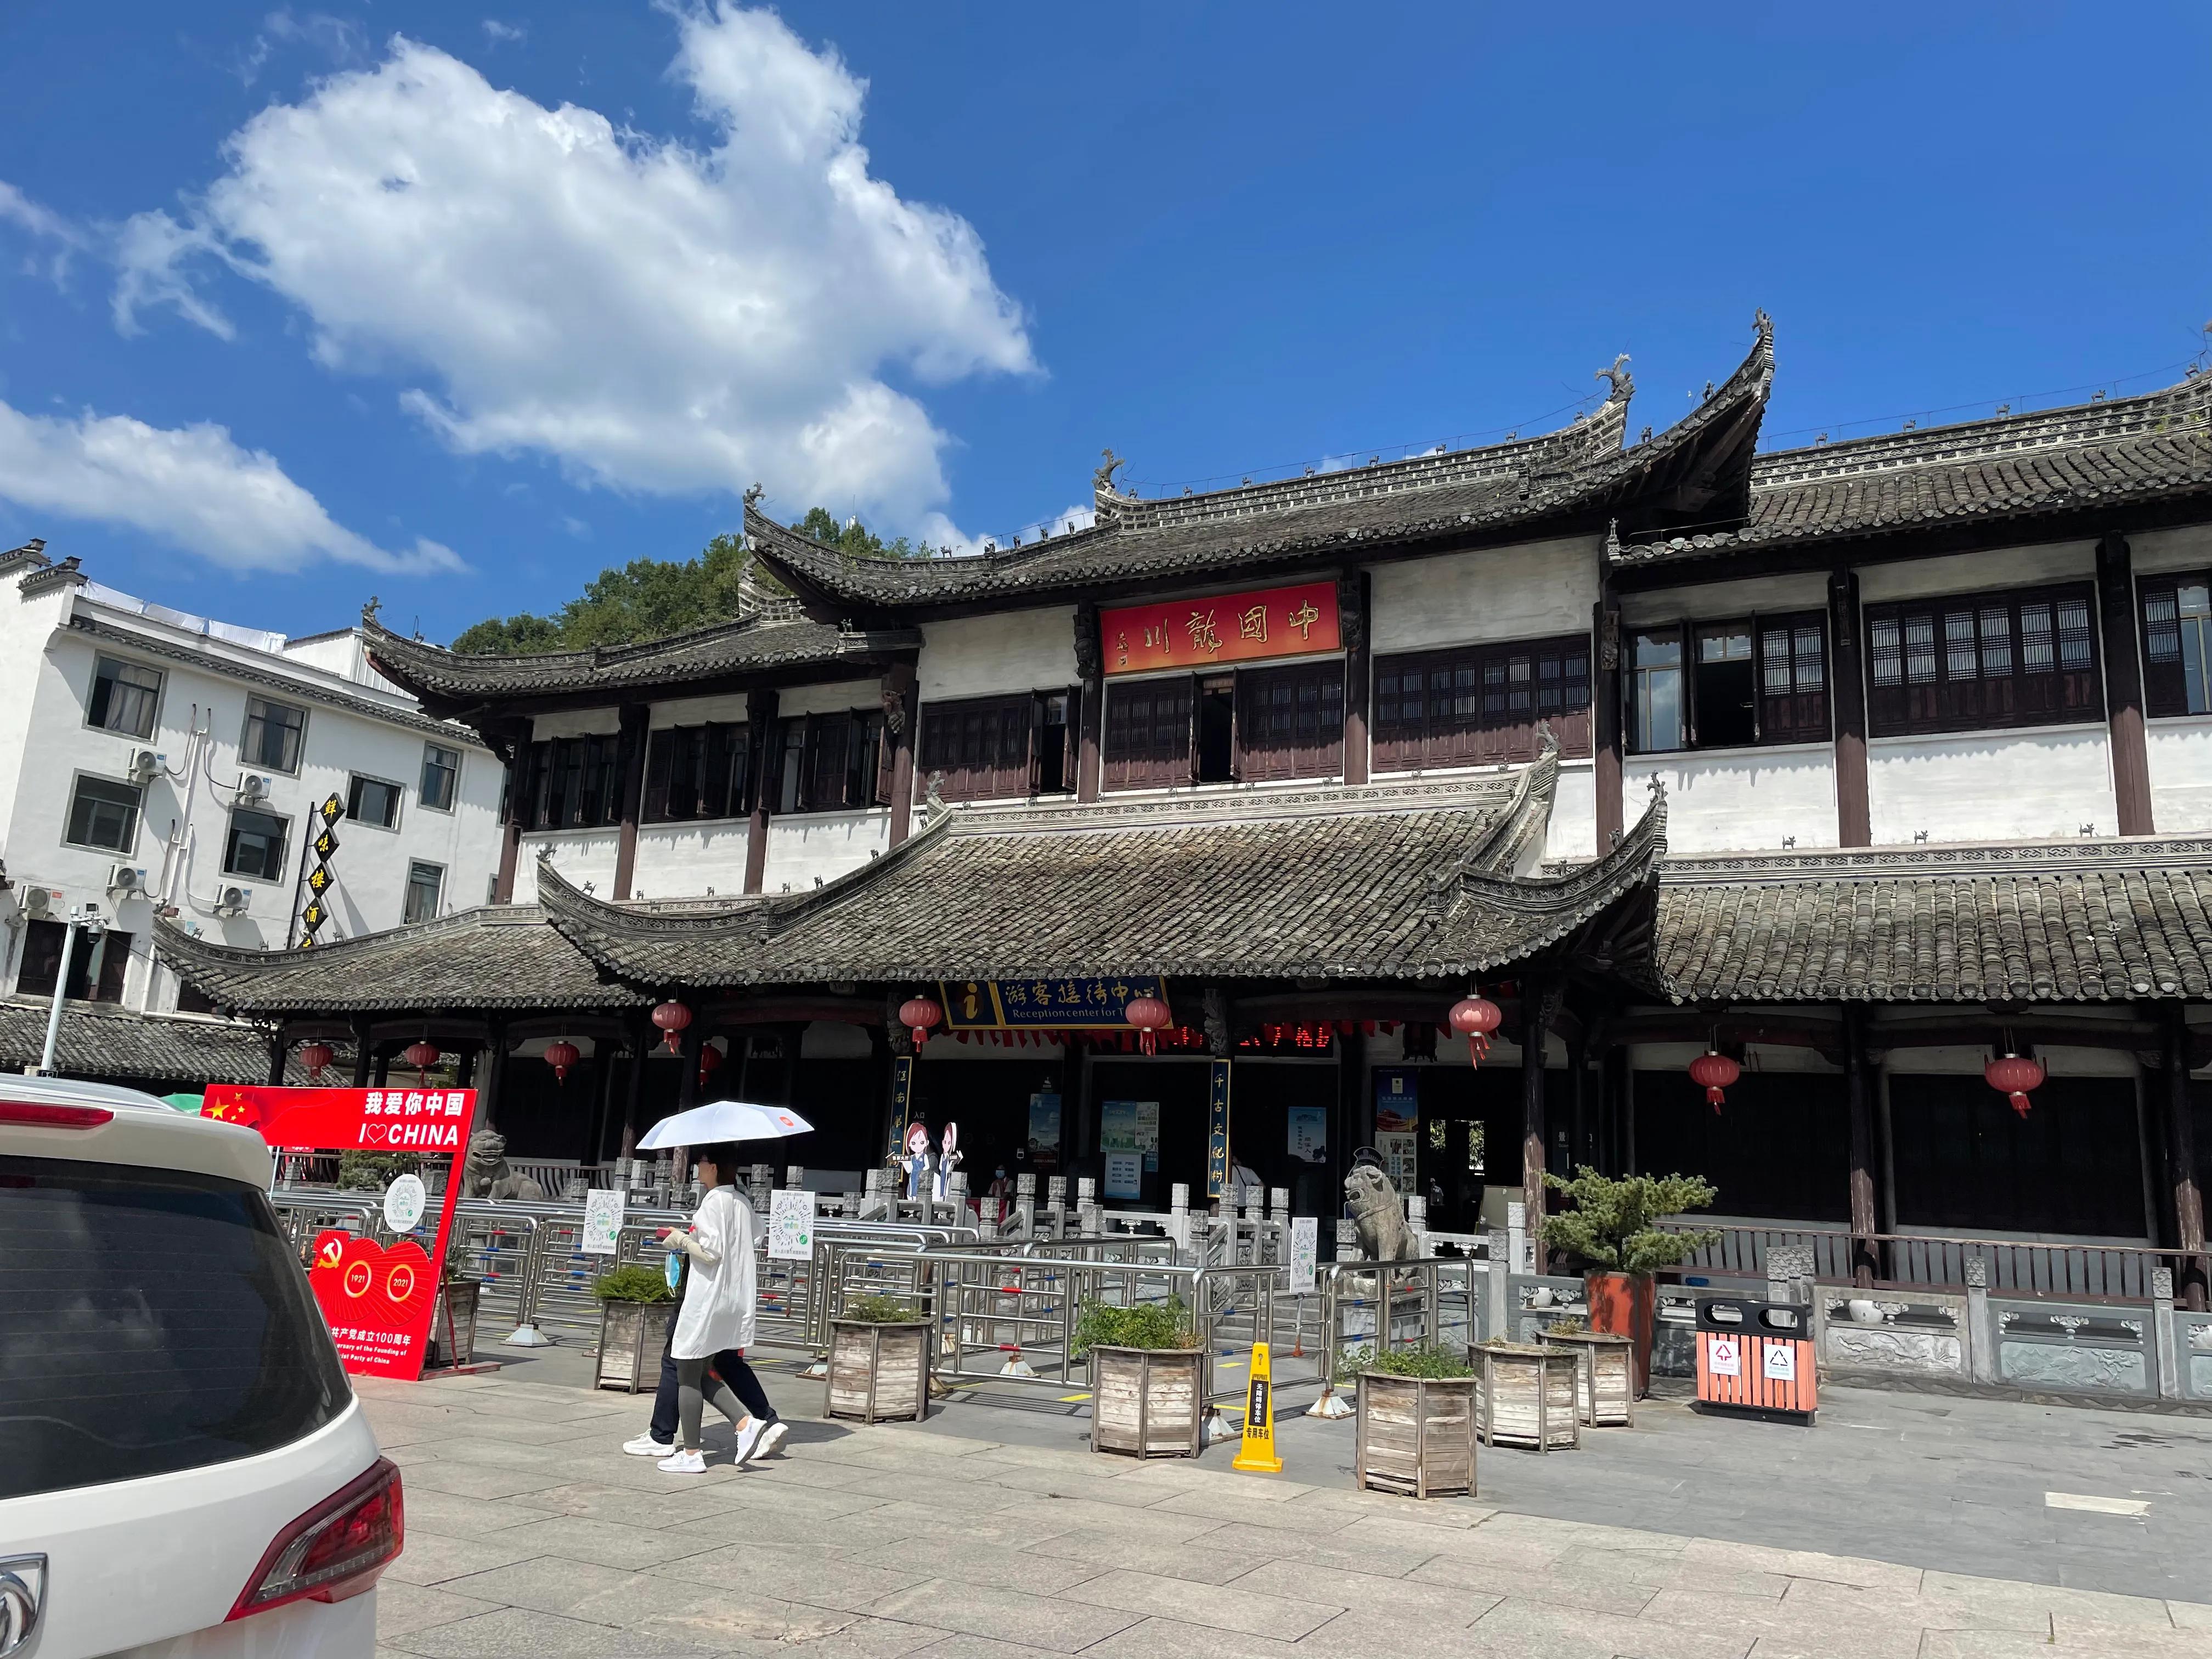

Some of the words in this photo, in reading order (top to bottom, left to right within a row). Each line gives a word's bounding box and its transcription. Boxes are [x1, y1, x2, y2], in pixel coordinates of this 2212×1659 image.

[1101, 1006, 1117, 1017] for
[364, 1091, 465, 1117] 我爱你中国
[1210, 1073, 1224, 1184] 千古文化村
[358, 1124, 366, 1143] I
[387, 1124, 459, 1146] CHINA
[351, 1274, 365, 1284] 1921
[393, 1278, 409, 1288] 2021
[330, 1327, 412, 1346] 共产党成立100周年
[350, 1354, 365, 1362] Party
[374, 1347, 399, 1357] Founding
[1246, 1427, 1269, 1440] 专用车位
